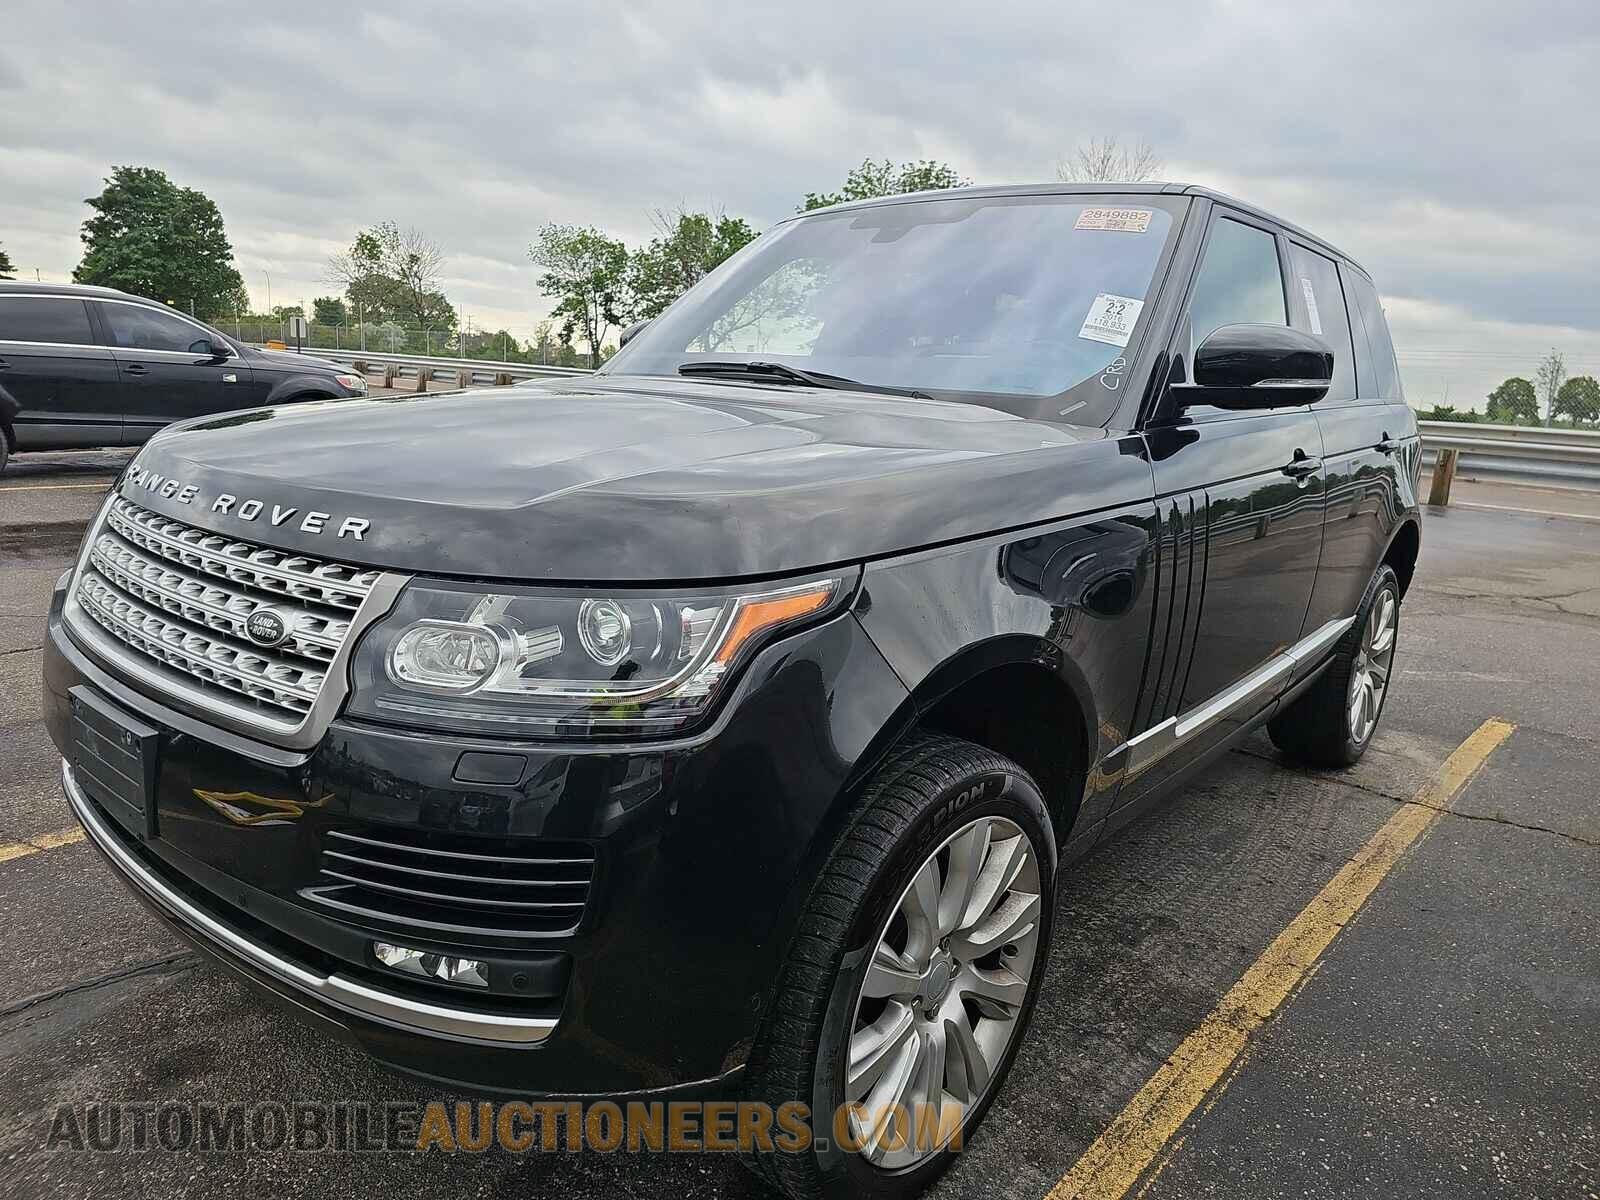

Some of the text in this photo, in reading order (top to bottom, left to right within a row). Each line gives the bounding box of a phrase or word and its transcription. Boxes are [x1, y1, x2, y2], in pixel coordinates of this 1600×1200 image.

[1102, 313, 1123, 323] 2016
[126, 463, 371, 541] RANGE ROVER
